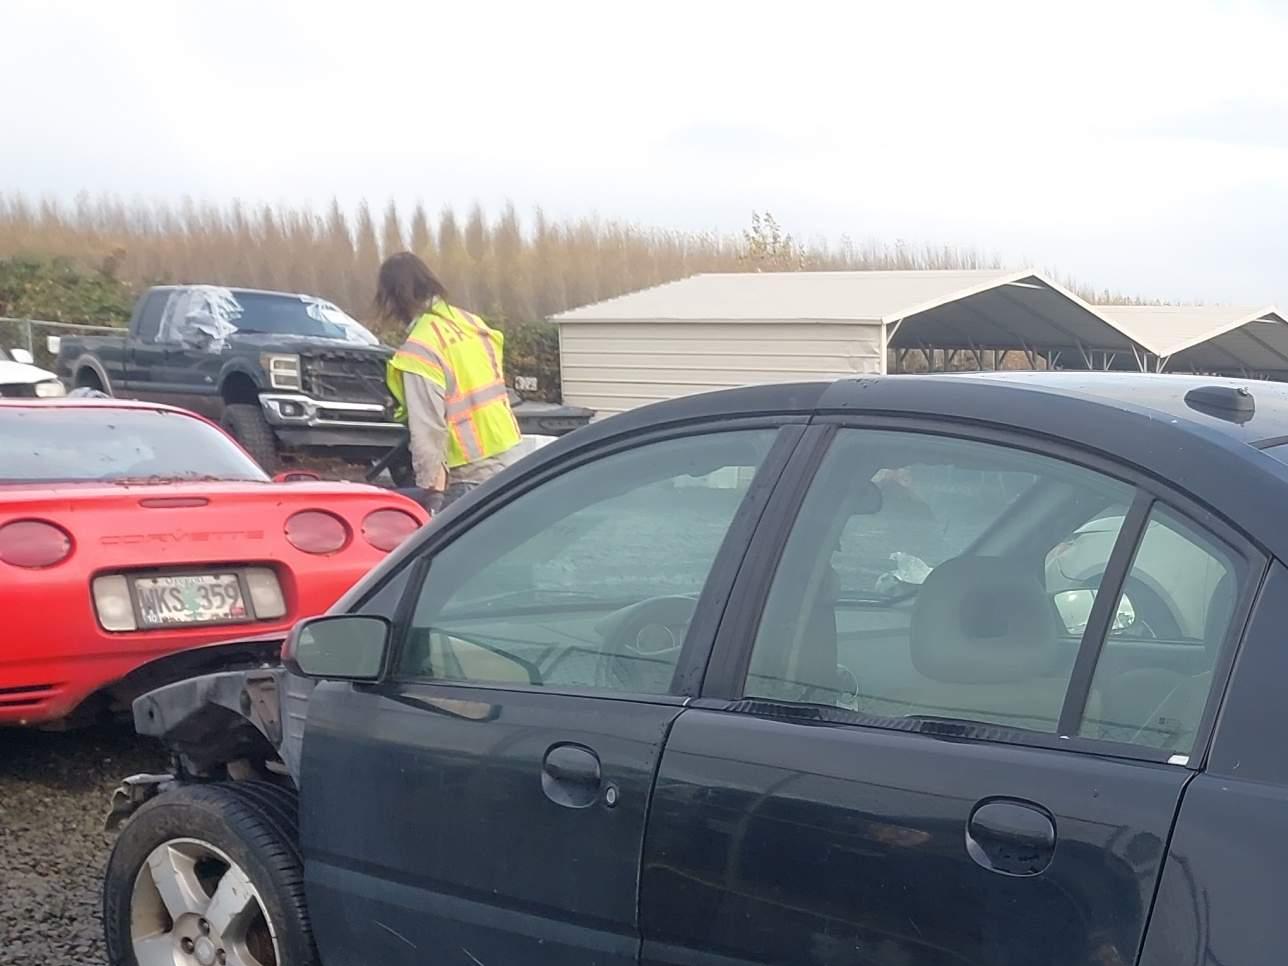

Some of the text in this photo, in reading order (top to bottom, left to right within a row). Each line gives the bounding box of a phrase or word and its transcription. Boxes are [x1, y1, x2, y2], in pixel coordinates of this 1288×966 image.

[100, 530, 265, 545] CORVETTE
[139, 580, 241, 616] WKS 359
